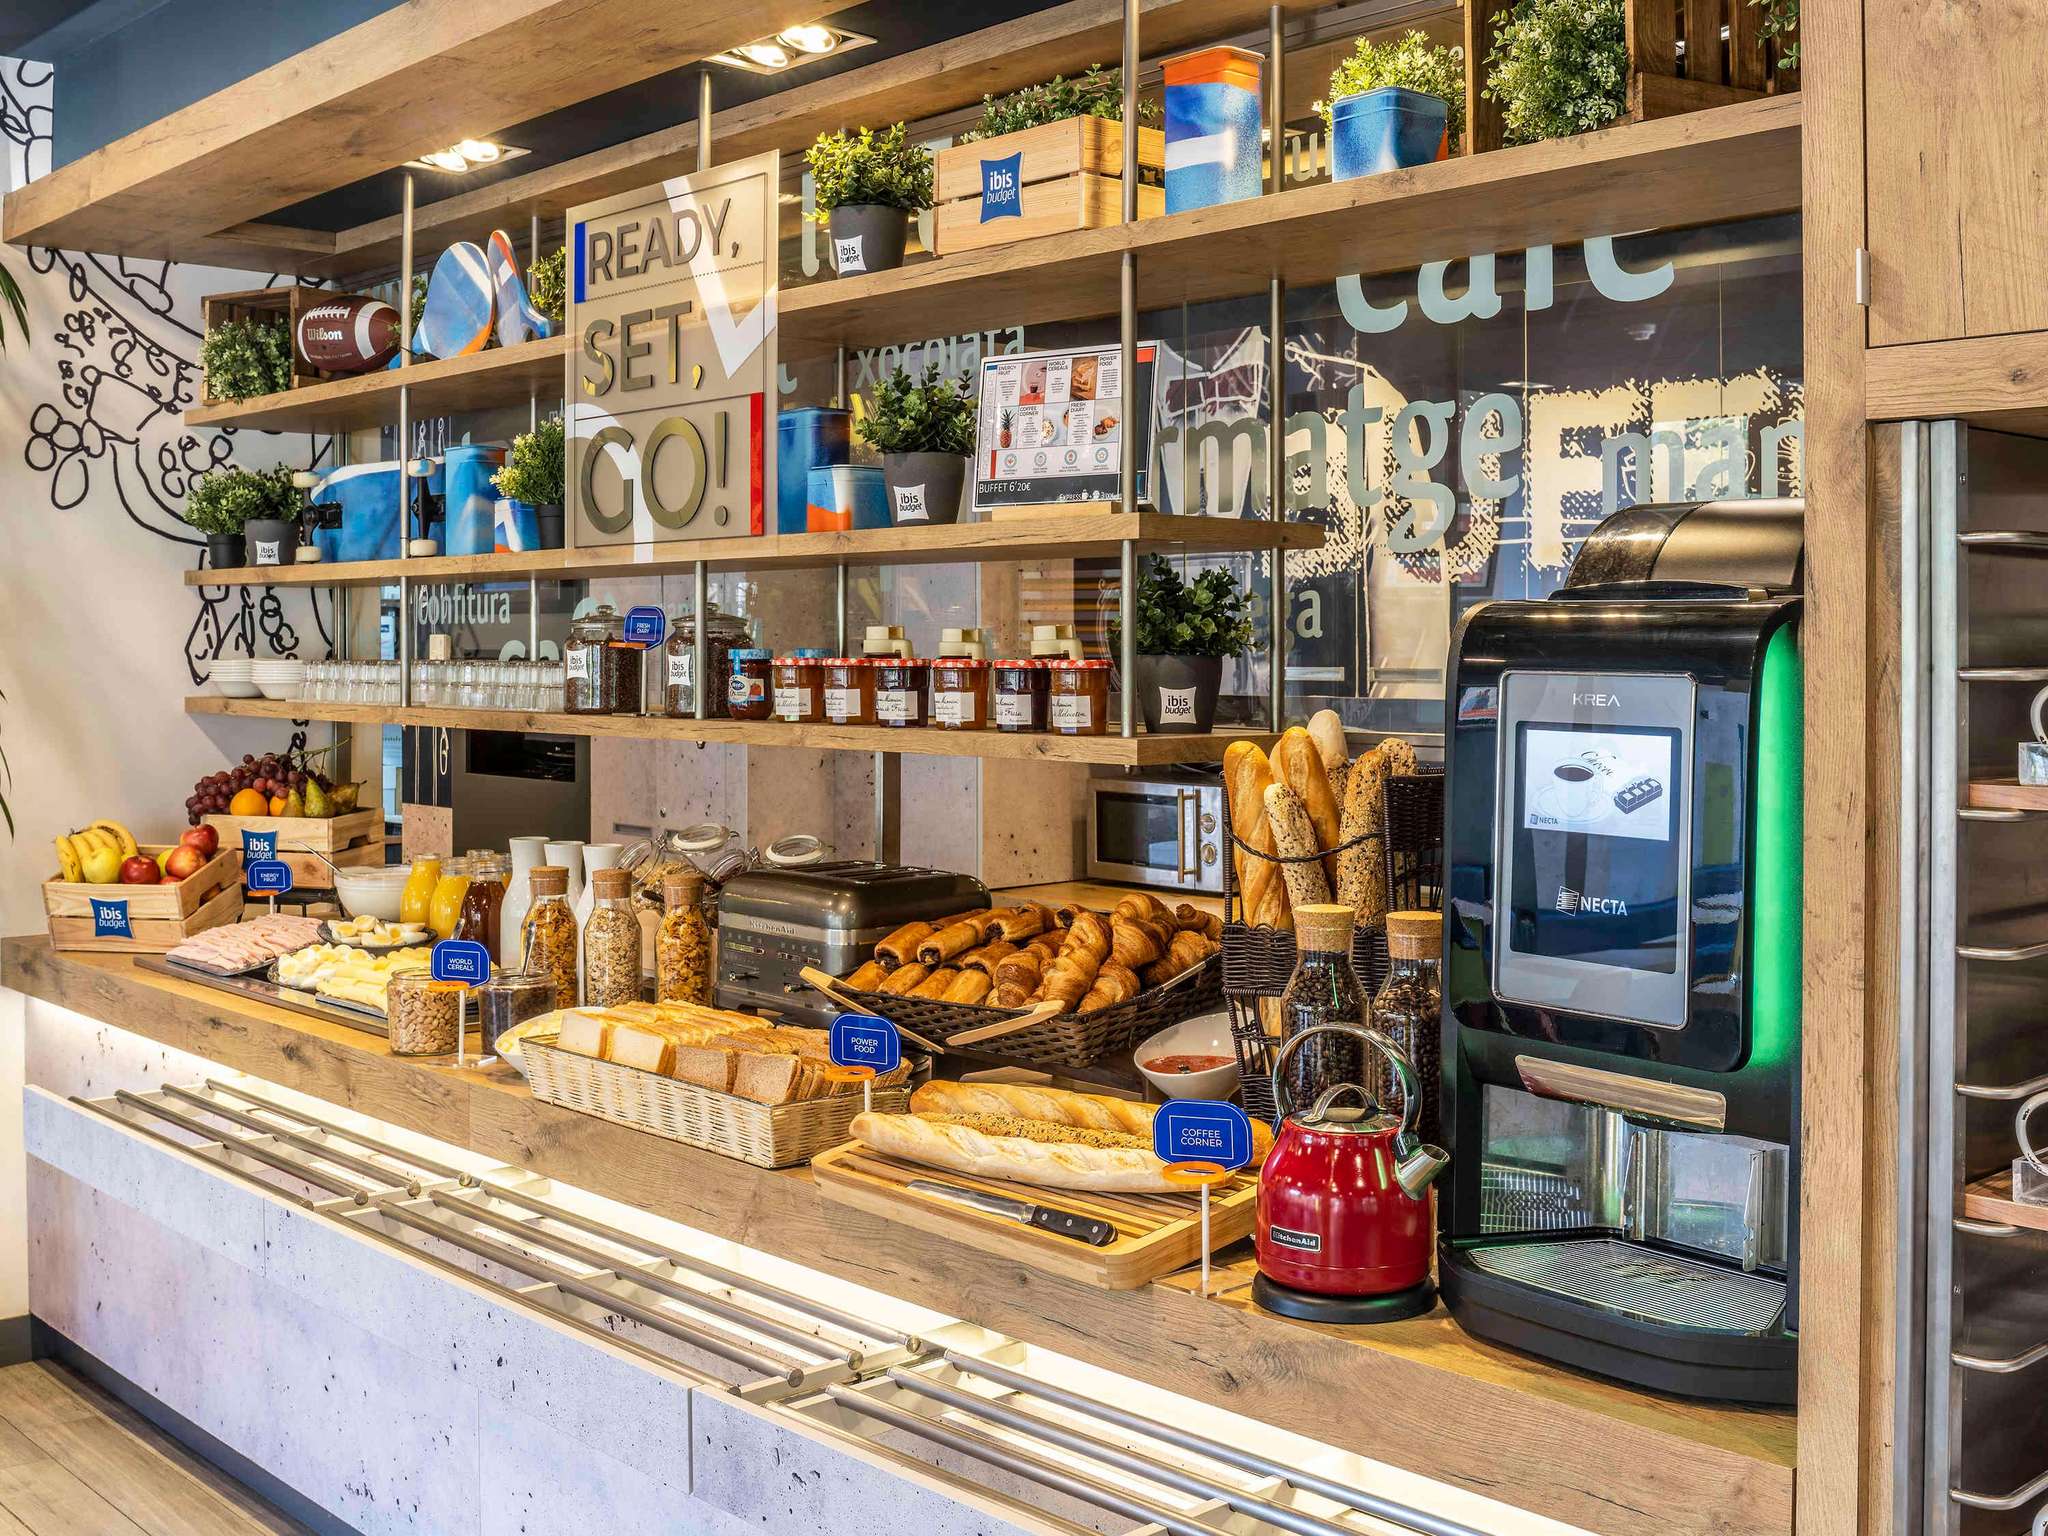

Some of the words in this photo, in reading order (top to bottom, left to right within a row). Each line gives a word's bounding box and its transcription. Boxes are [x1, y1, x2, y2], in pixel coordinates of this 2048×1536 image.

[989, 169, 1012, 190] ibis
[986, 186, 1016, 205] budget
[588, 197, 740, 285] READY,
[840, 245, 857, 256] ibis
[839, 253, 860, 264] budget
[306, 327, 343, 341] Wilson
[582, 300, 703, 397] SET,
[581, 411, 729, 535] GO!
[979, 482, 1008, 494] BUFFET
[900, 493, 919, 504] ibis
[899, 503, 922, 512] budget
[260, 546, 274, 554] ibis
[569, 655, 582, 665] ibis
[671, 661, 684, 670] ibis
[1167, 695, 1188, 706] ibis
[1164, 705, 1192, 716] budget
[1539, 816, 1559, 825] NECTA
[249, 838, 271, 851] ibis
[246, 850, 273, 860] budget
[1580, 896, 1628, 916] NECTA
[100, 906, 123, 920] ibis
[98, 918, 127, 930] budget
[447, 963, 475, 972] CEREALS
[448, 958, 473, 966] WORLD
[851, 1037, 879, 1047] POWER
[854, 1045, 876, 1054] FOOD
[1181, 1127, 1221, 1139] COFFEE
[1180, 1136, 1223, 1148] CORNER
